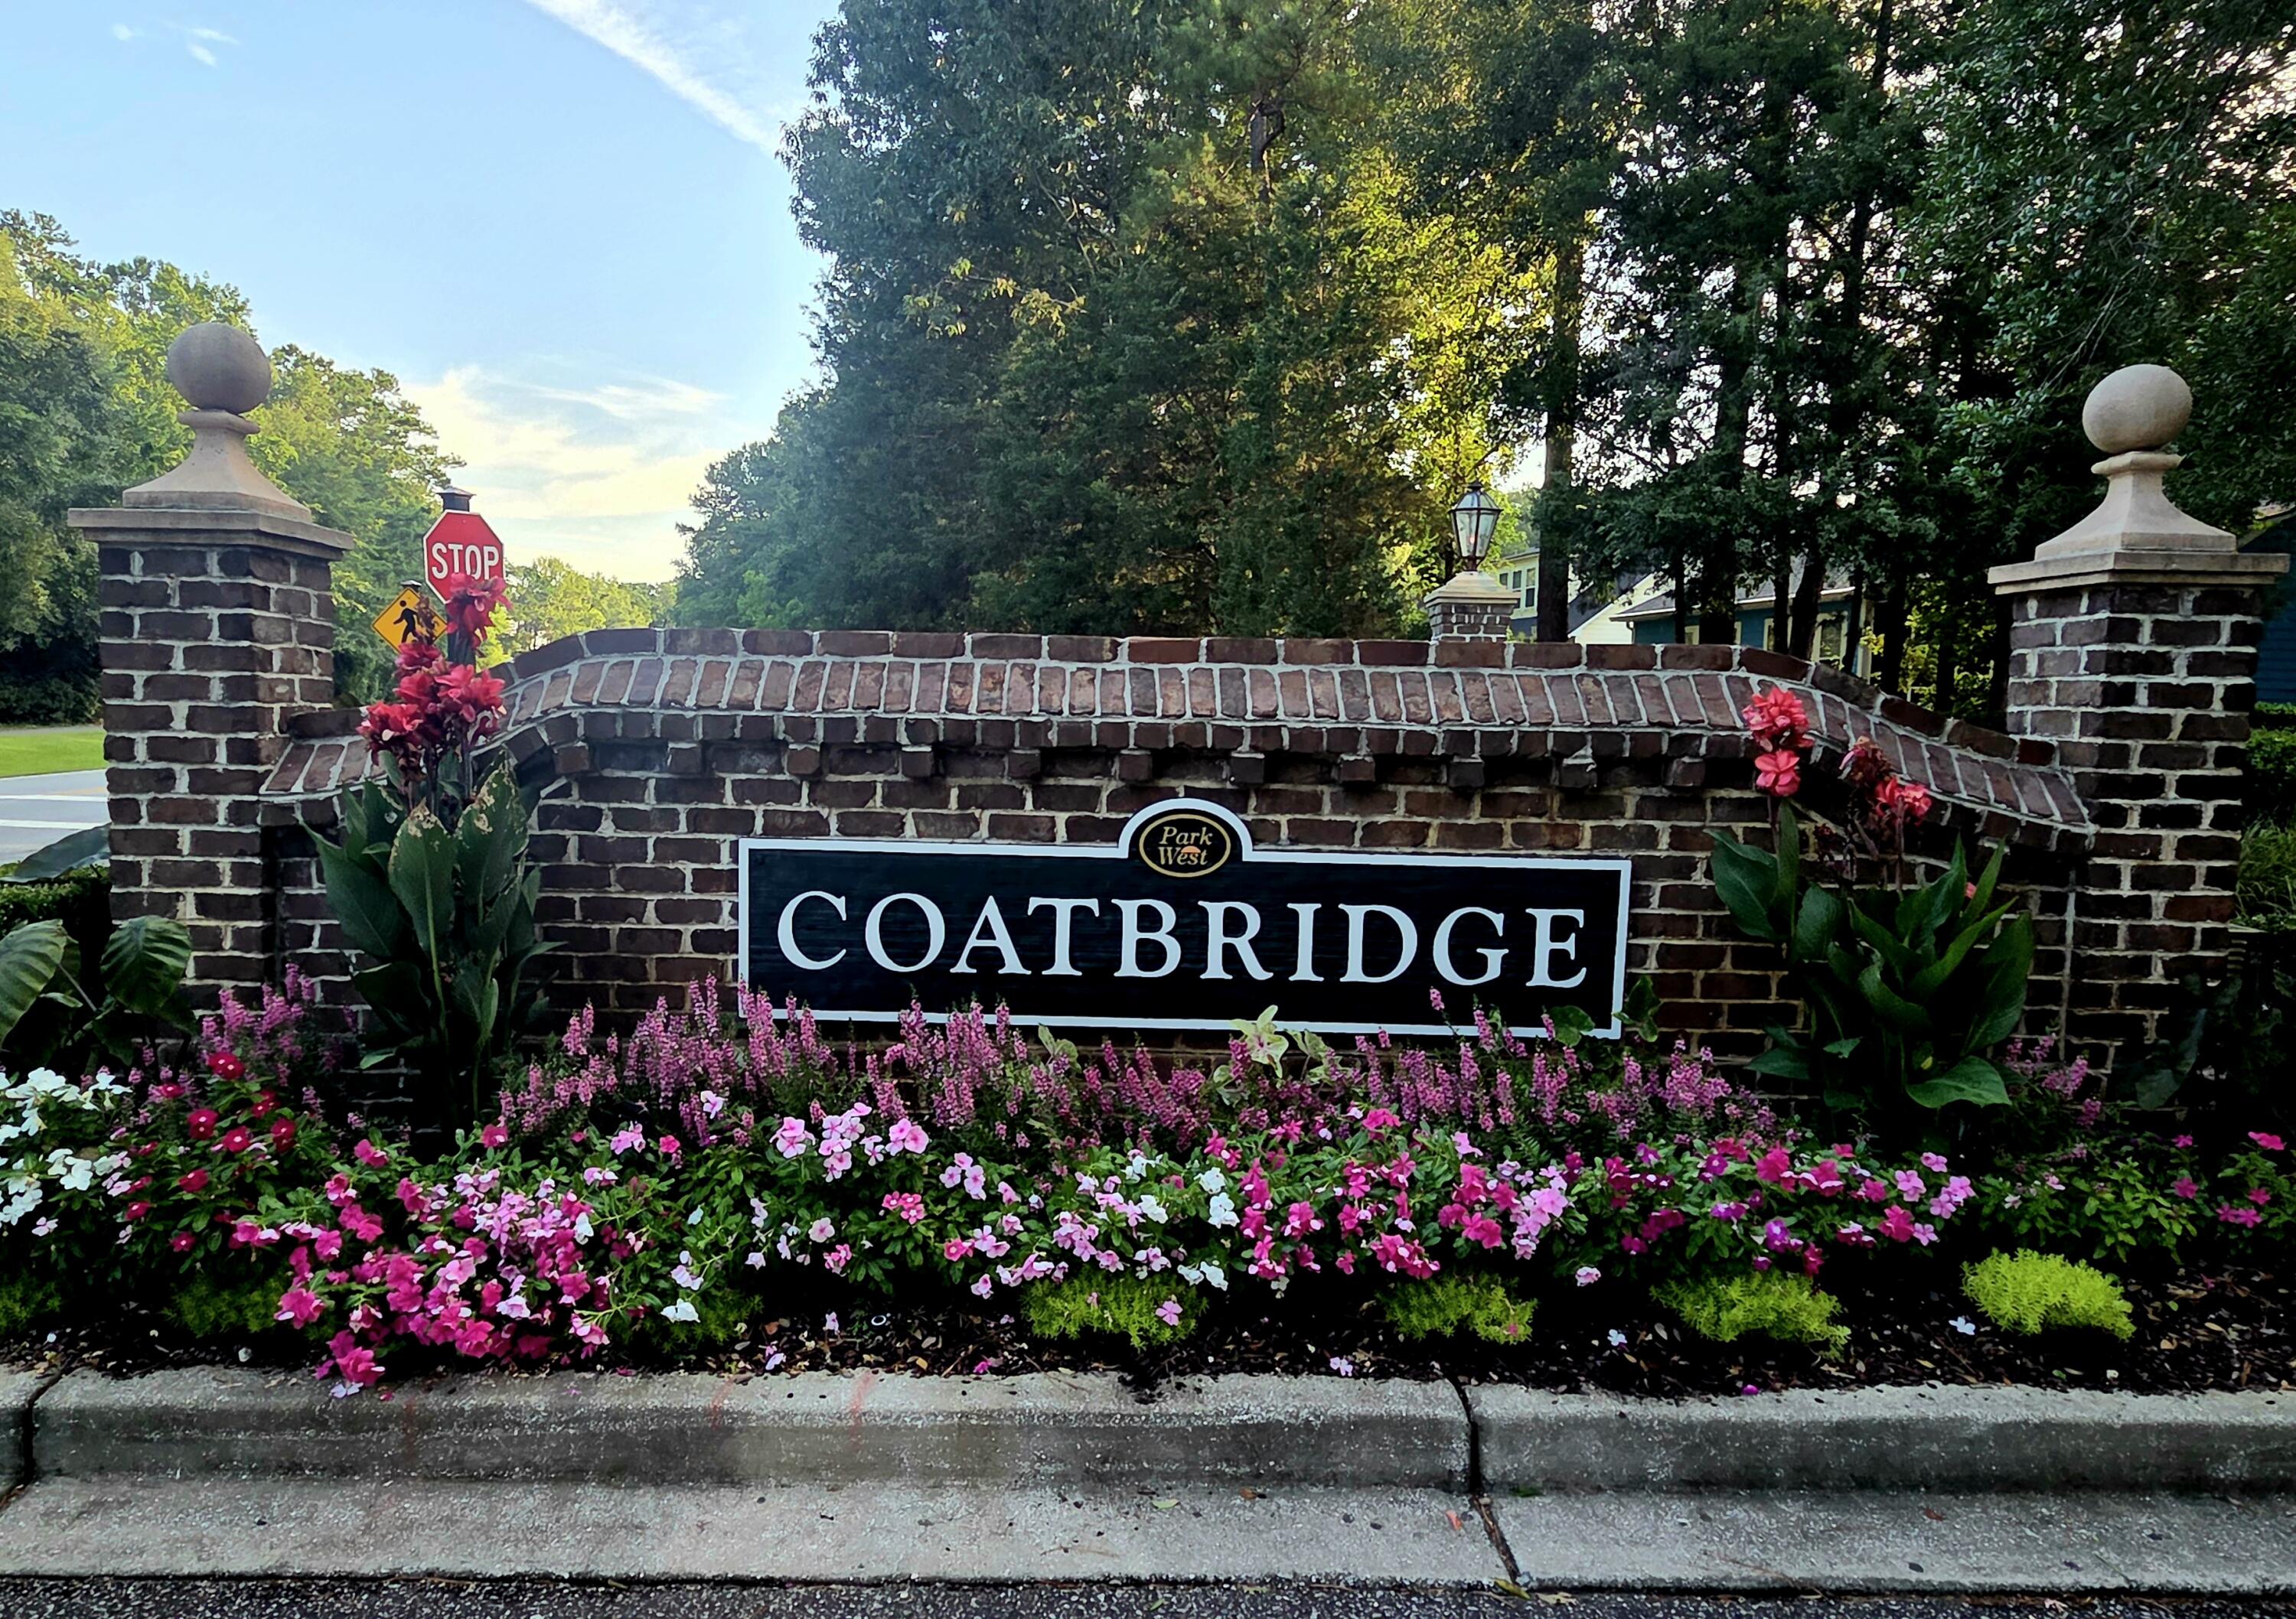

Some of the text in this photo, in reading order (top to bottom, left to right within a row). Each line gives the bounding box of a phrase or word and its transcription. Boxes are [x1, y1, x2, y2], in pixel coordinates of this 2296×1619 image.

[432, 542, 499, 580] STOP
[1159, 826, 1213, 845] Park
[1157, 846, 1208, 865] West
[777, 891, 1588, 988] COATBRIDGE
